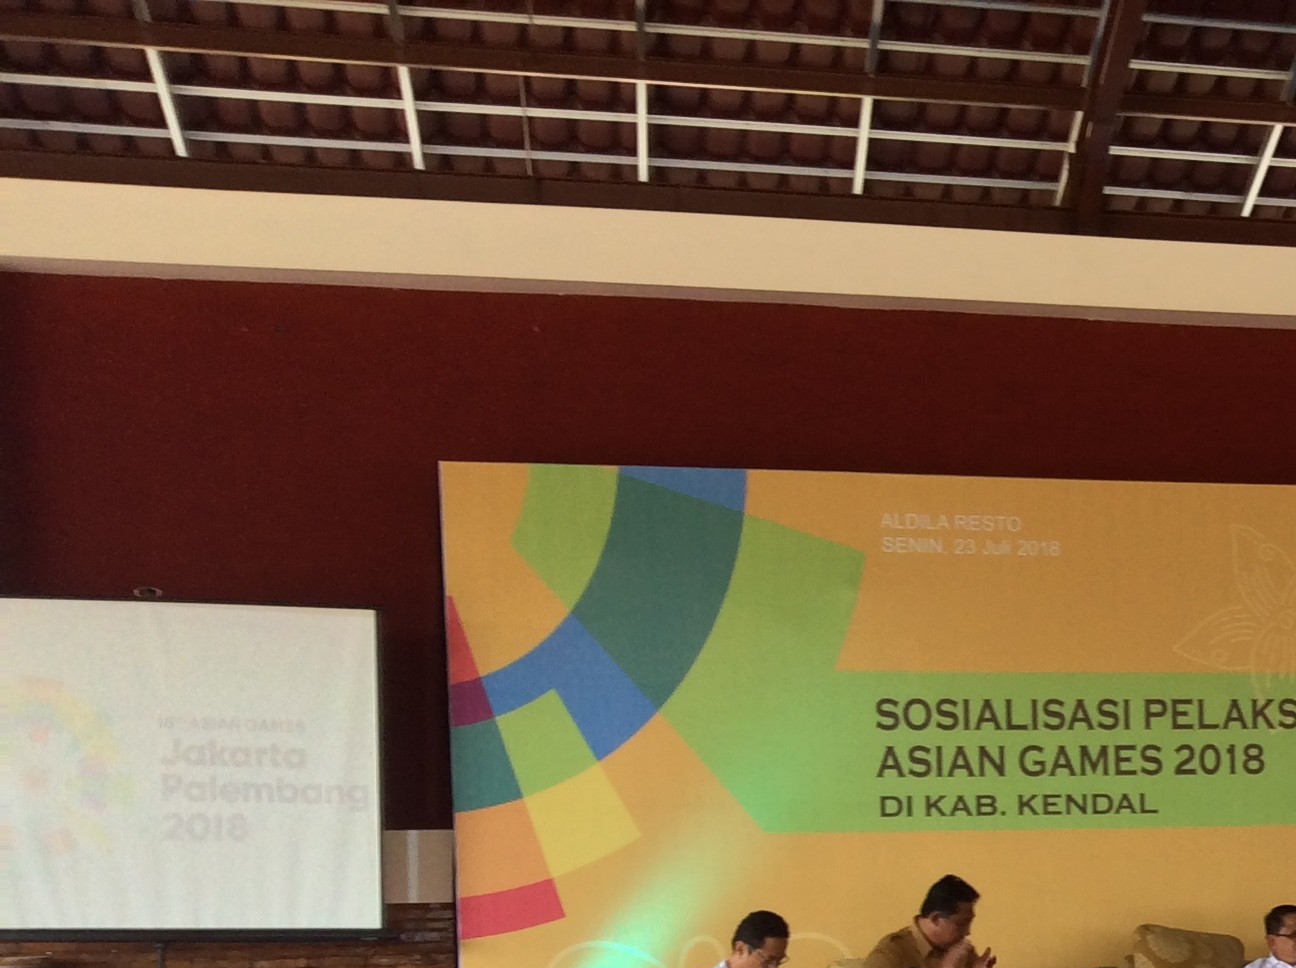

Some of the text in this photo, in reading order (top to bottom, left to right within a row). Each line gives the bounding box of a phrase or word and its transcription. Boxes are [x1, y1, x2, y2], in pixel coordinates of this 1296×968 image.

[880, 512, 1023, 532] ALDILA RESTO
[953, 538, 977, 555] 23
[1017, 540, 1062, 556] 2018
[875, 698, 1133, 732] SOSIALISASI
[160, 738, 307, 769] Jakarta
[876, 743, 1266, 778] ASIAN GAMES 2018
[160, 773, 369, 813] Palembang
[879, 792, 1160, 818] DI KAB. KENDAL
[161, 812, 250, 843] 2018
